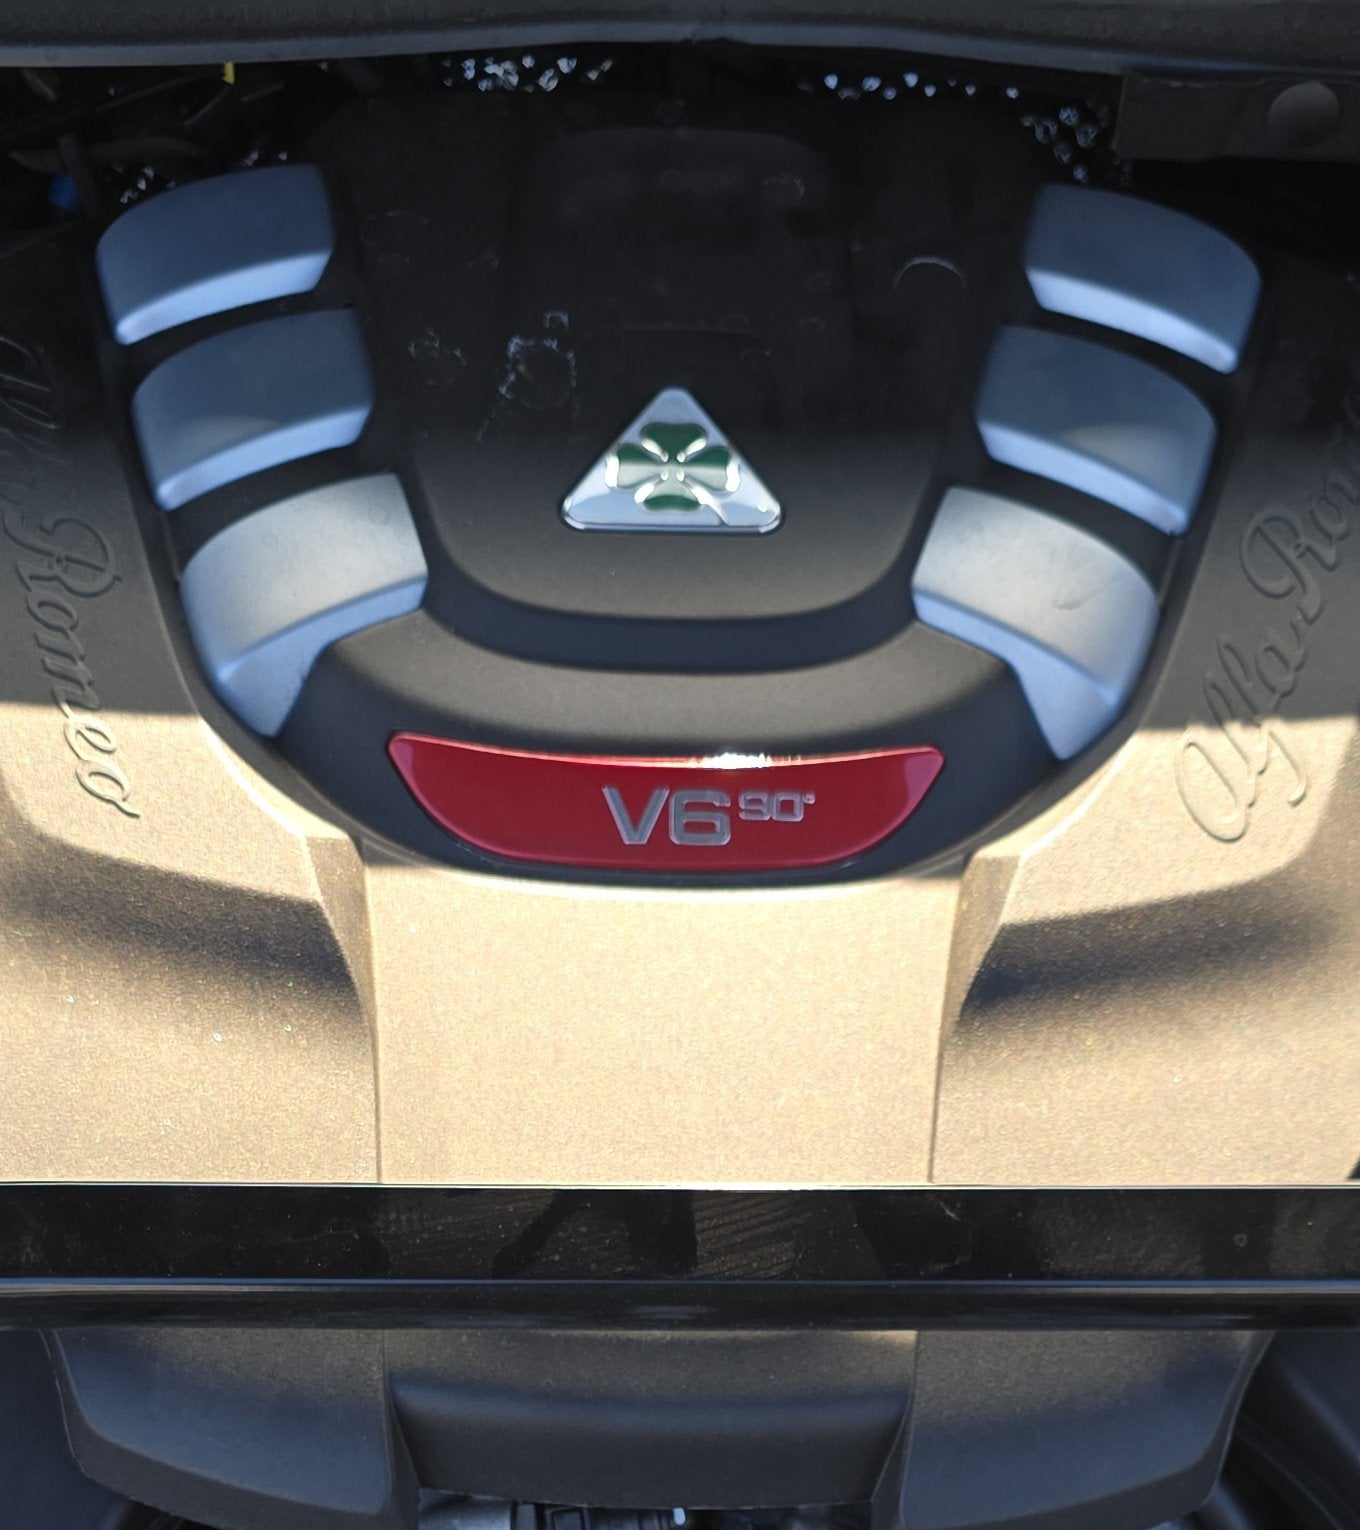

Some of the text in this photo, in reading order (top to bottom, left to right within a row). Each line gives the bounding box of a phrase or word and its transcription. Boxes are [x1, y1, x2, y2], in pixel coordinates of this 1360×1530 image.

[2, 515, 141, 819] Romeo
[1173, 632, 1308, 843] Alfa
[601, 785, 732, 847] V6
